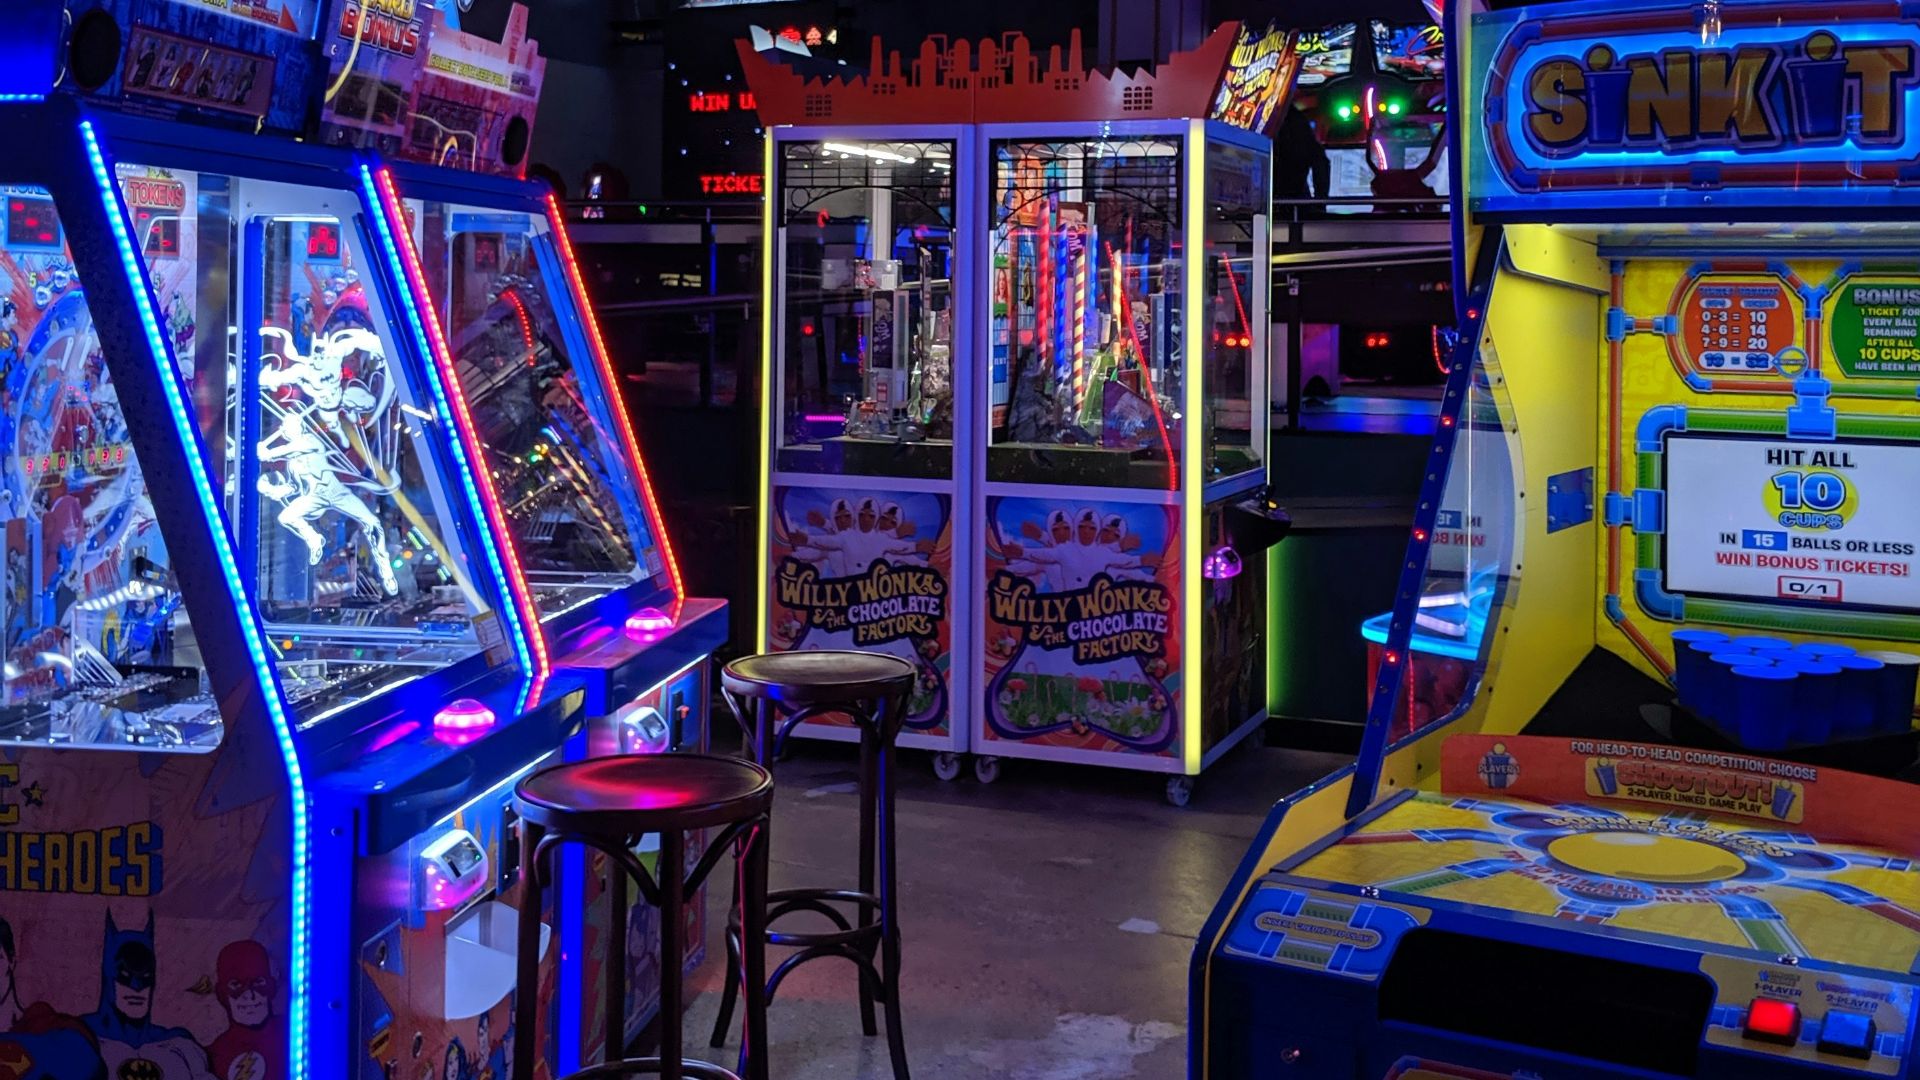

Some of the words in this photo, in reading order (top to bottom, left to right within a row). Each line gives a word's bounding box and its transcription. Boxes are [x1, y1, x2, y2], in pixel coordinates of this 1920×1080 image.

[340, 2, 420, 56] BONUS
[690, 94, 730, 111] WIN
[739, 94, 757, 110] U
[701, 174, 765, 193] TICKE
[129, 182, 184, 207] TOKENS
[1854, 288, 1920, 305] BONUS
[1749, 311, 1767, 323] 10
[1868, 308, 1900, 316] TICKET
[1902, 308, 1920, 317] FOR
[1750, 324, 1767, 336] 14
[1863, 318, 1893, 326] EVERY
[1895, 318, 1918, 327] BALL
[1863, 328, 1918, 337] REMAINING
[1748, 337, 1768, 350] 20
[1867, 339, 1895, 347] AFTER
[1859, 348, 1877, 360] 10
[1881, 348, 1920, 361] CUPS
[1855, 362, 1879, 371] HAVE
[1881, 362, 1905, 371] BEEN
[1767, 449, 1805, 466] HIT
[1811, 450, 1856, 468] ALL
[1771, 471, 1846, 511] 10
[1778, 511, 1845, 530] CUPS
[1719, 532, 1737, 545] IN
[1752, 533, 1775, 548] 15
[1791, 536, 1842, 552] BALLS
[1846, 540, 1870, 553] OR
[1873, 542, 1915, 556] LESS
[1715, 552, 1751, 567] WIN
[1756, 555, 1819, 572] BONUS
[1823, 559, 1910, 577] TICKETS!
[780, 562, 852, 606] WILLY
[857, 564, 943, 601] WONKA
[1789, 582, 1828, 595] 0/1
[993, 576, 1072, 623] WILLY
[1077, 578, 1171, 619] WONKA
[826, 614, 847, 629] THE
[848, 596, 941, 624] CHOCOLATE
[857, 614, 931, 642] FACTORY
[1044, 632, 1066, 646] THE
[1067, 612, 1168, 641] CHOCOLATE
[1078, 631, 1159, 660] FACTORY
[1478, 764, 1514, 775] PLAYER
[1571, 741, 1594, 754] FOR
[1597, 743, 1682, 762] HEAD-TO-HEAD
[1684, 751, 1766, 773] COMPETITION
[1768, 763, 1817, 781] CHOOSE
[1616, 761, 1773, 804] SHOOTOUT!
[1627, 787, 1673, 802] 2-PLAYER
[1673, 792, 1707, 806] LINKED
[1708, 797, 1736, 811] GAME
[1738, 803, 1762, 815] PLAY
[1754, 982, 1802, 998] 1-PLAYER
[1826, 994, 1878, 1011] 2-PLAYER
